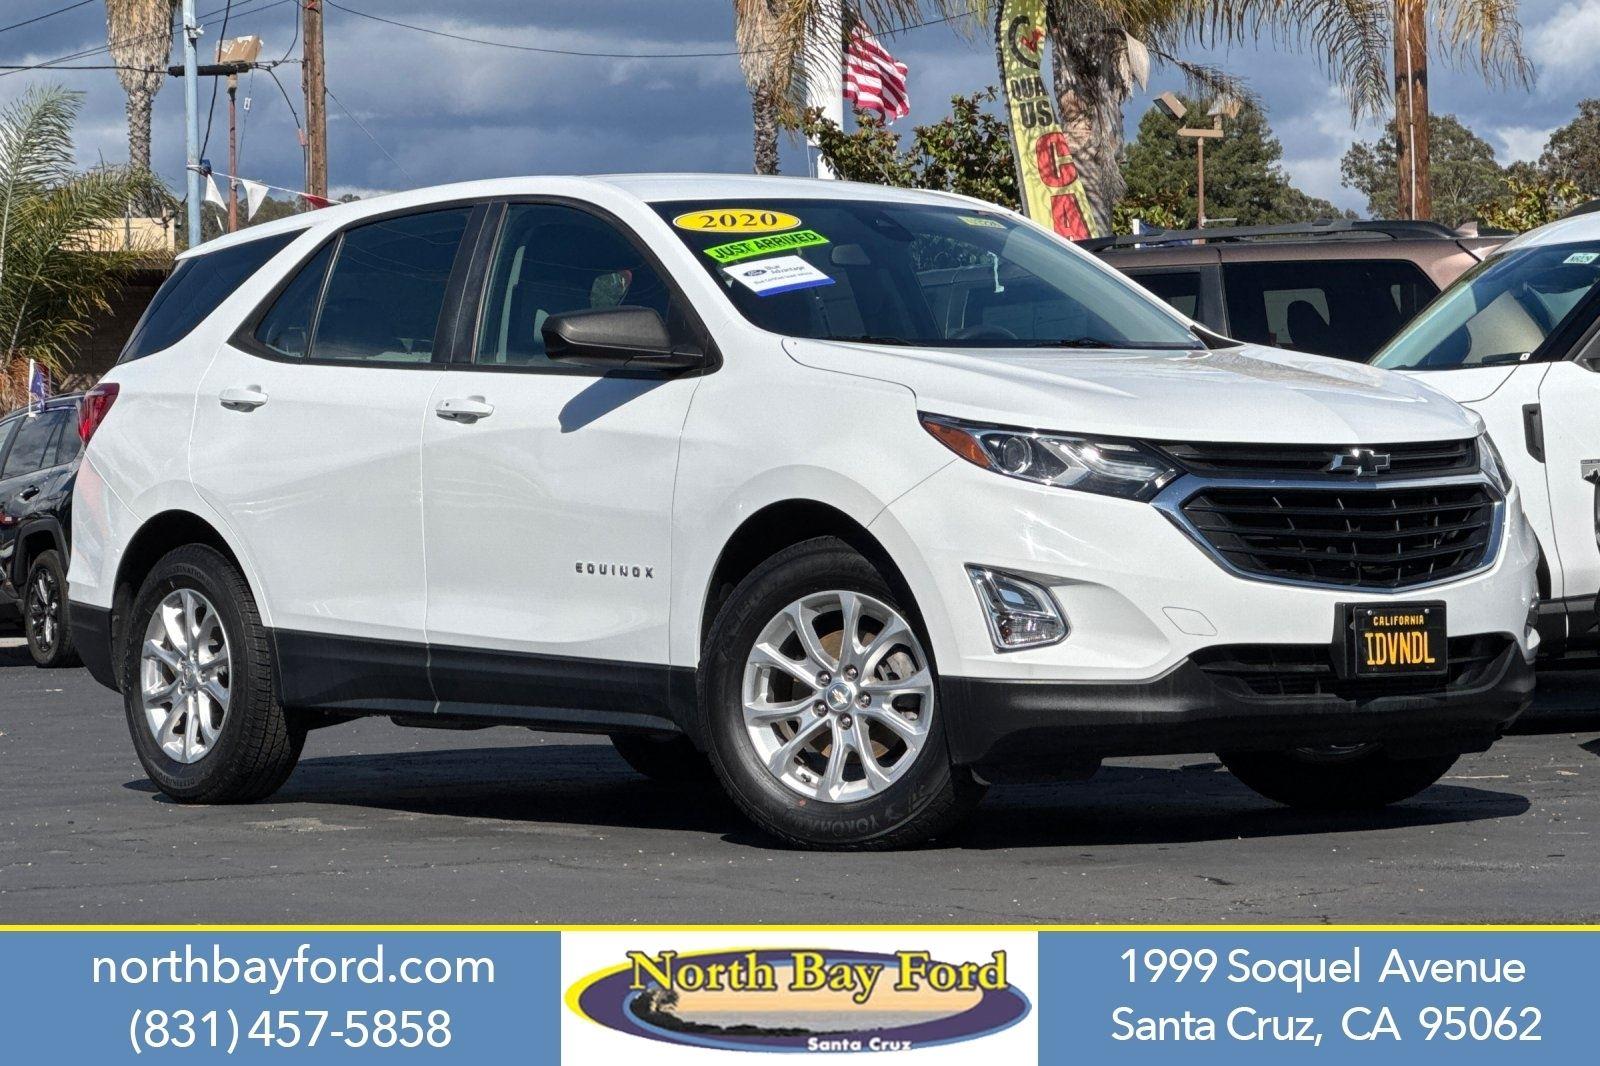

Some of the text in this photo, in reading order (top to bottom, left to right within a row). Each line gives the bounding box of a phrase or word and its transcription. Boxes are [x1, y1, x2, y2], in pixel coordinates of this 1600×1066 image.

[1019, 100, 1058, 129] US
[698, 212, 778, 229] 2020
[714, 232, 818, 259] JUST ARRIVED
[575, 562, 654, 579] EQUINOX
[1373, 614, 1425, 626] CALIFORNIA
[1364, 631, 1436, 665] IDVNDL
